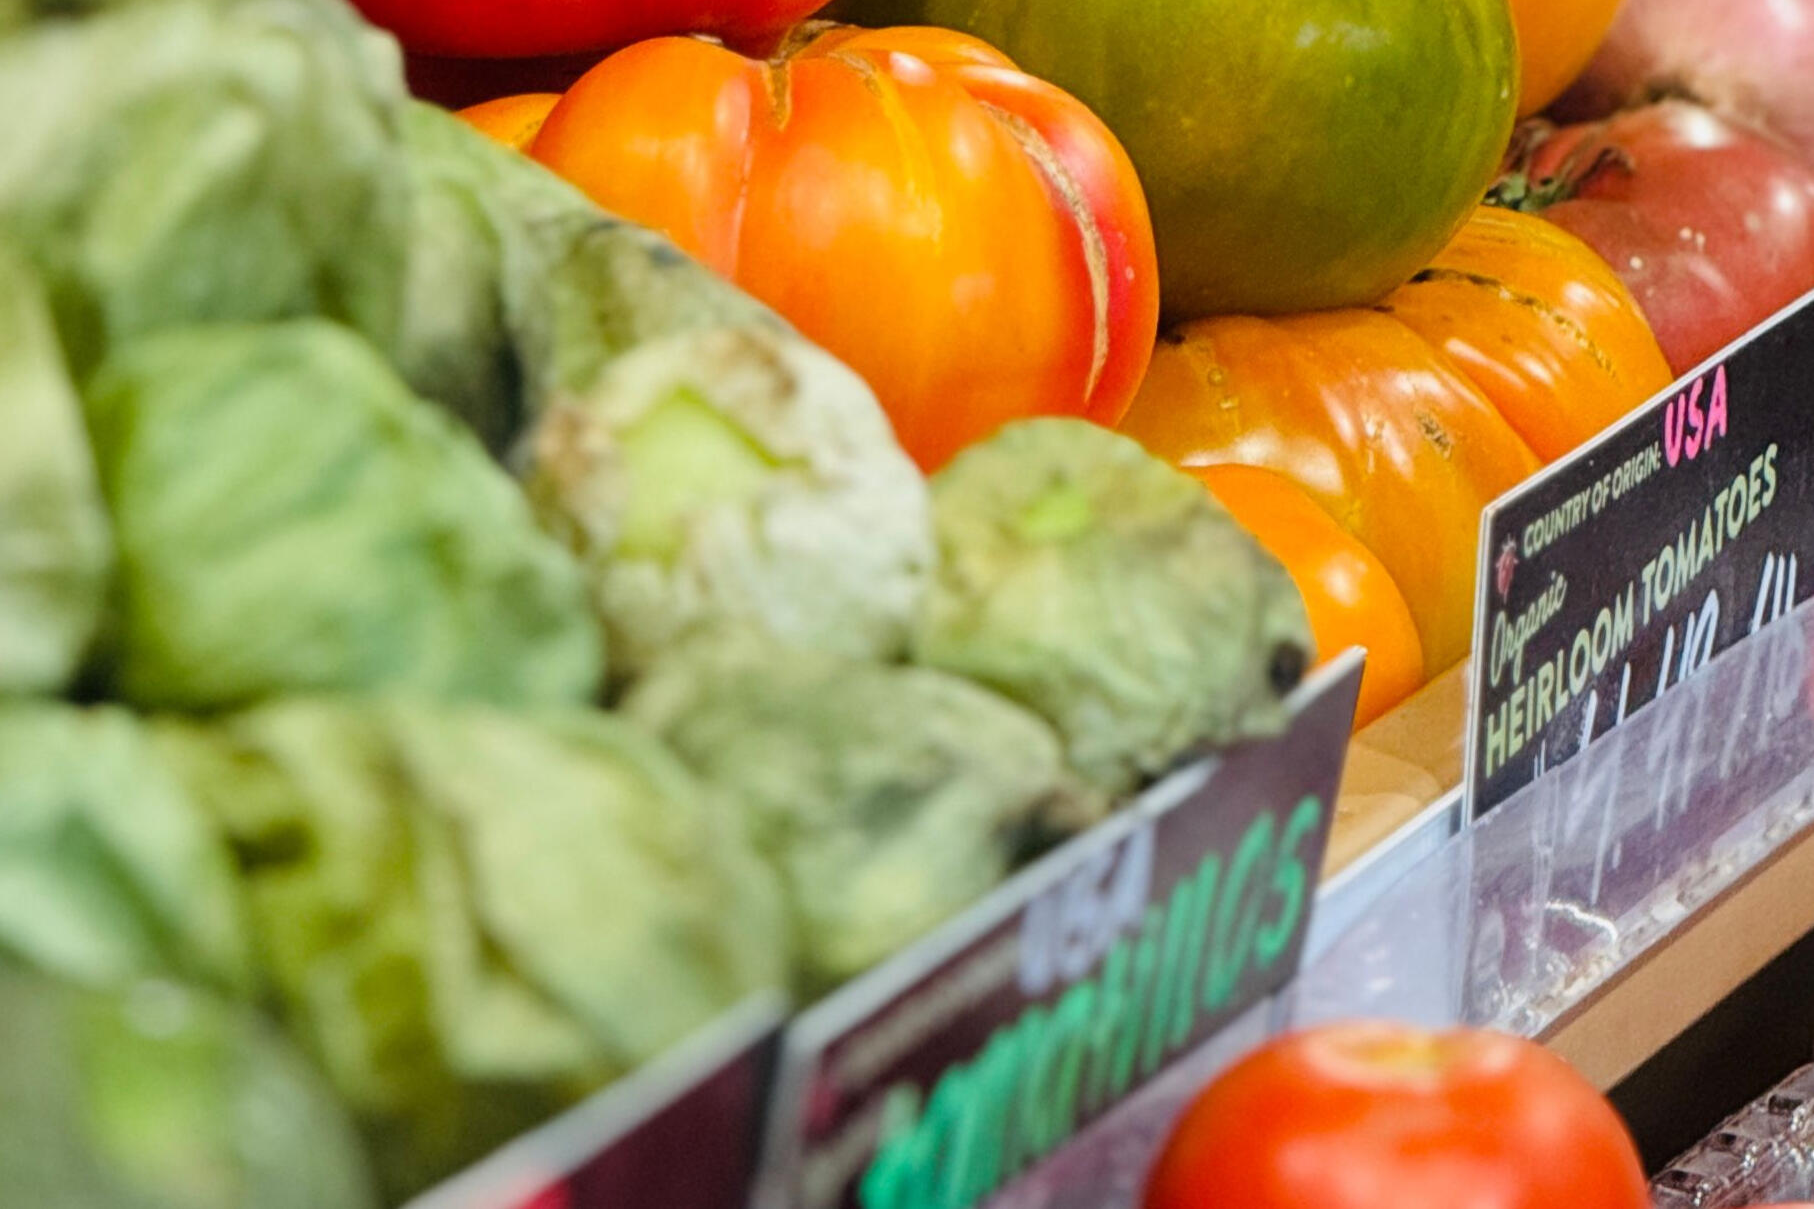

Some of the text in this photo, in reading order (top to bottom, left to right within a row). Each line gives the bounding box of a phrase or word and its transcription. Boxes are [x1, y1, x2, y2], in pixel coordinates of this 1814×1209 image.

[1523, 364, 1727, 559] COUNTRY OF ORIGIN: USA
[1486, 580, 1634, 779] HEIRLOOM
[1641, 442, 1778, 627] TOMATOES
[1490, 570, 1567, 687] Organic
